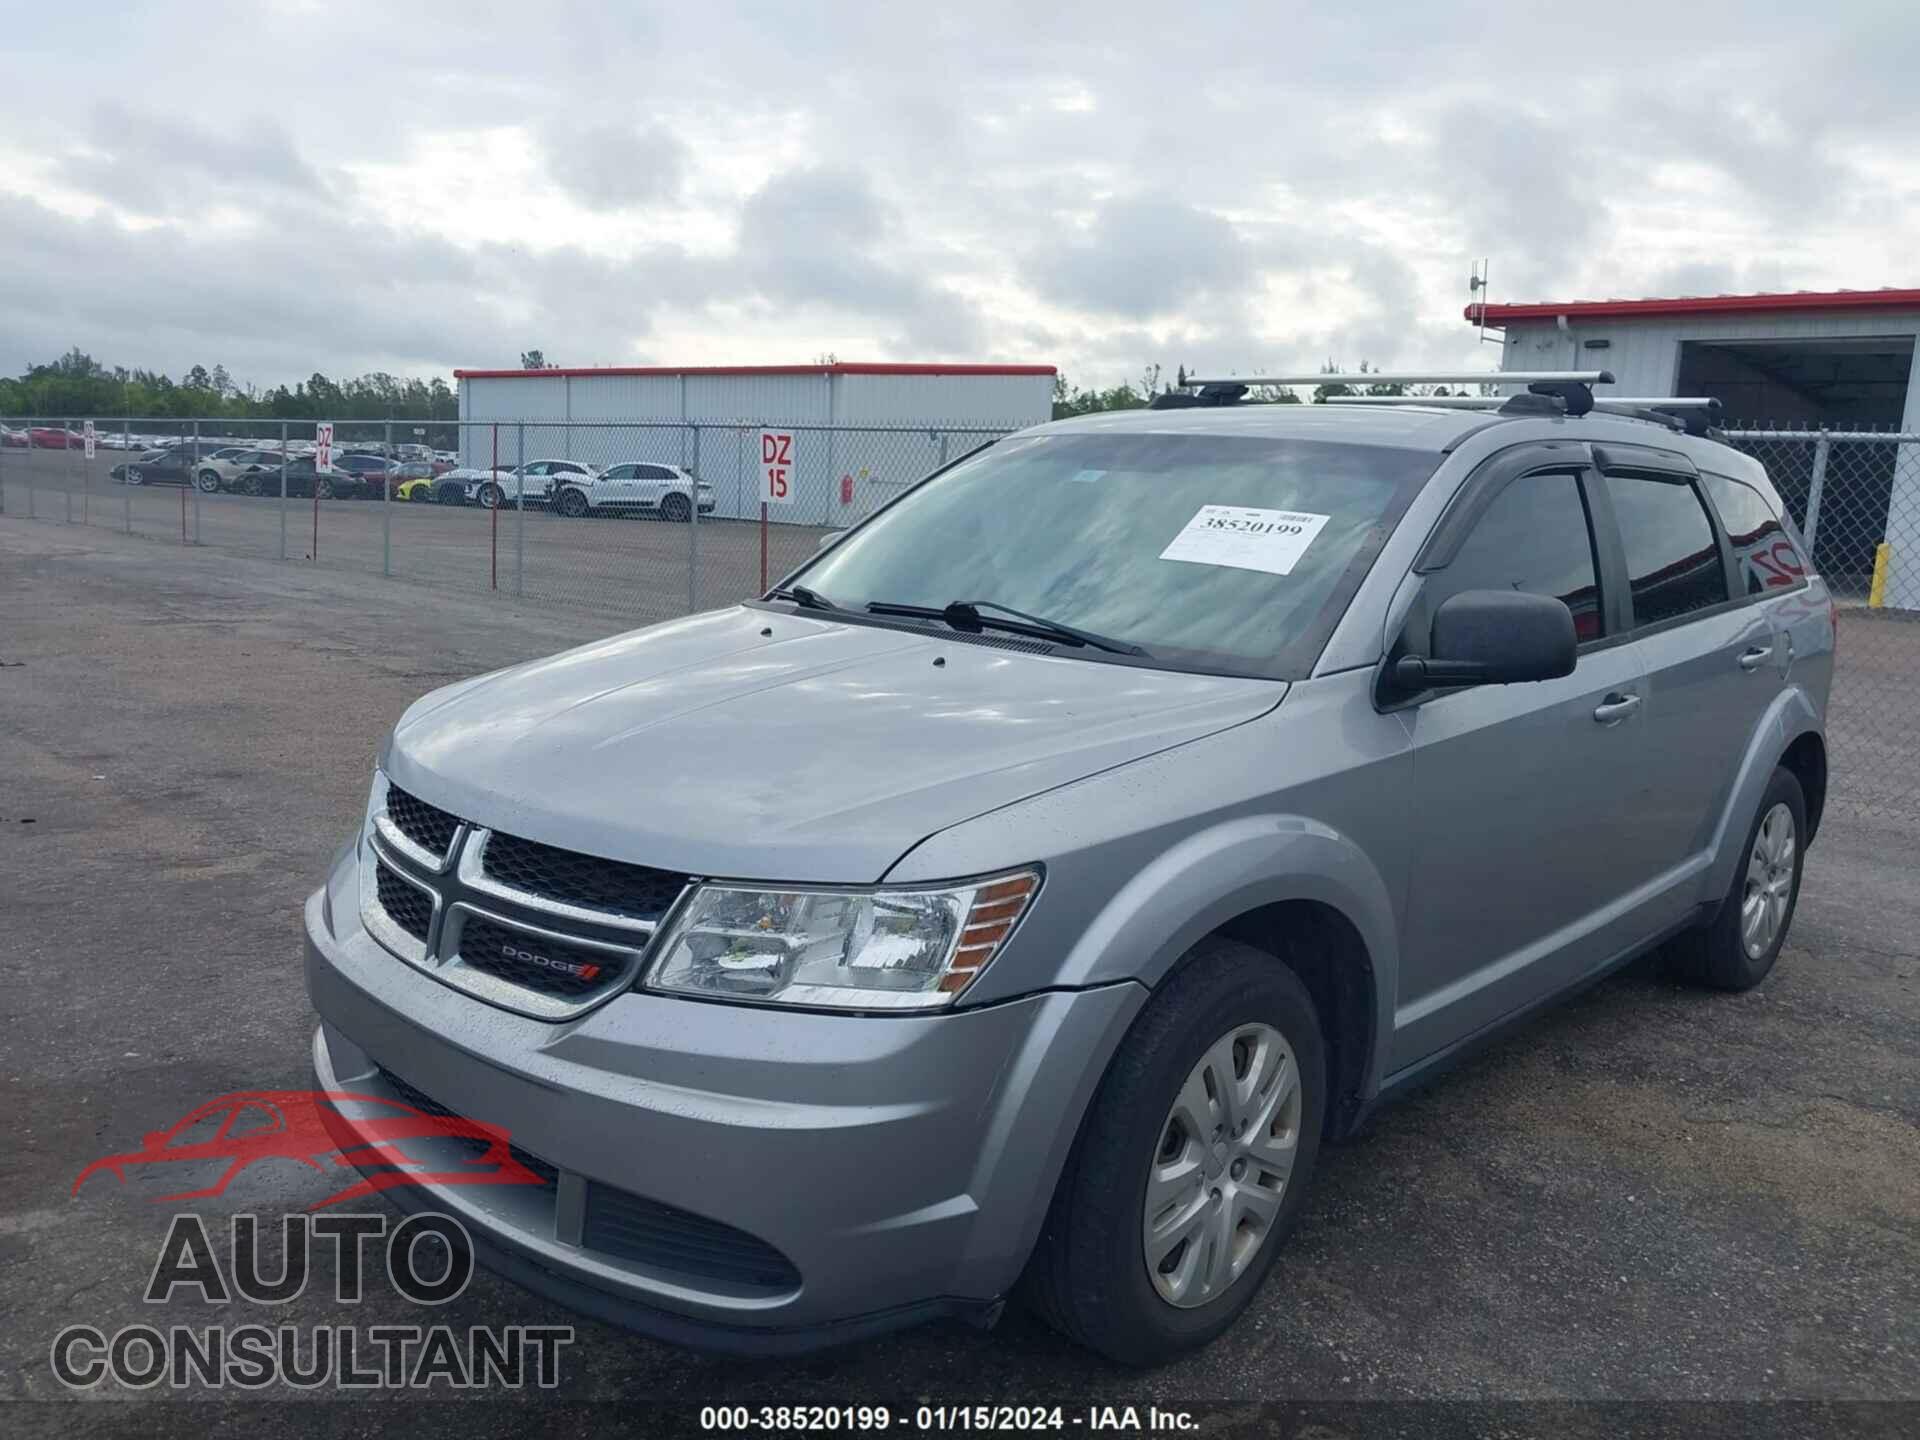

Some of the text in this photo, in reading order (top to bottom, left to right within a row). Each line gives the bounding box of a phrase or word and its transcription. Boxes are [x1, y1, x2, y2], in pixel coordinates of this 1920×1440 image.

[318, 427, 331, 447] DZ
[762, 434, 791, 465] DZ
[768, 468, 787, 497] 15
[1200, 517, 1303, 537] 38520199
[502, 945, 586, 975] DODGE
